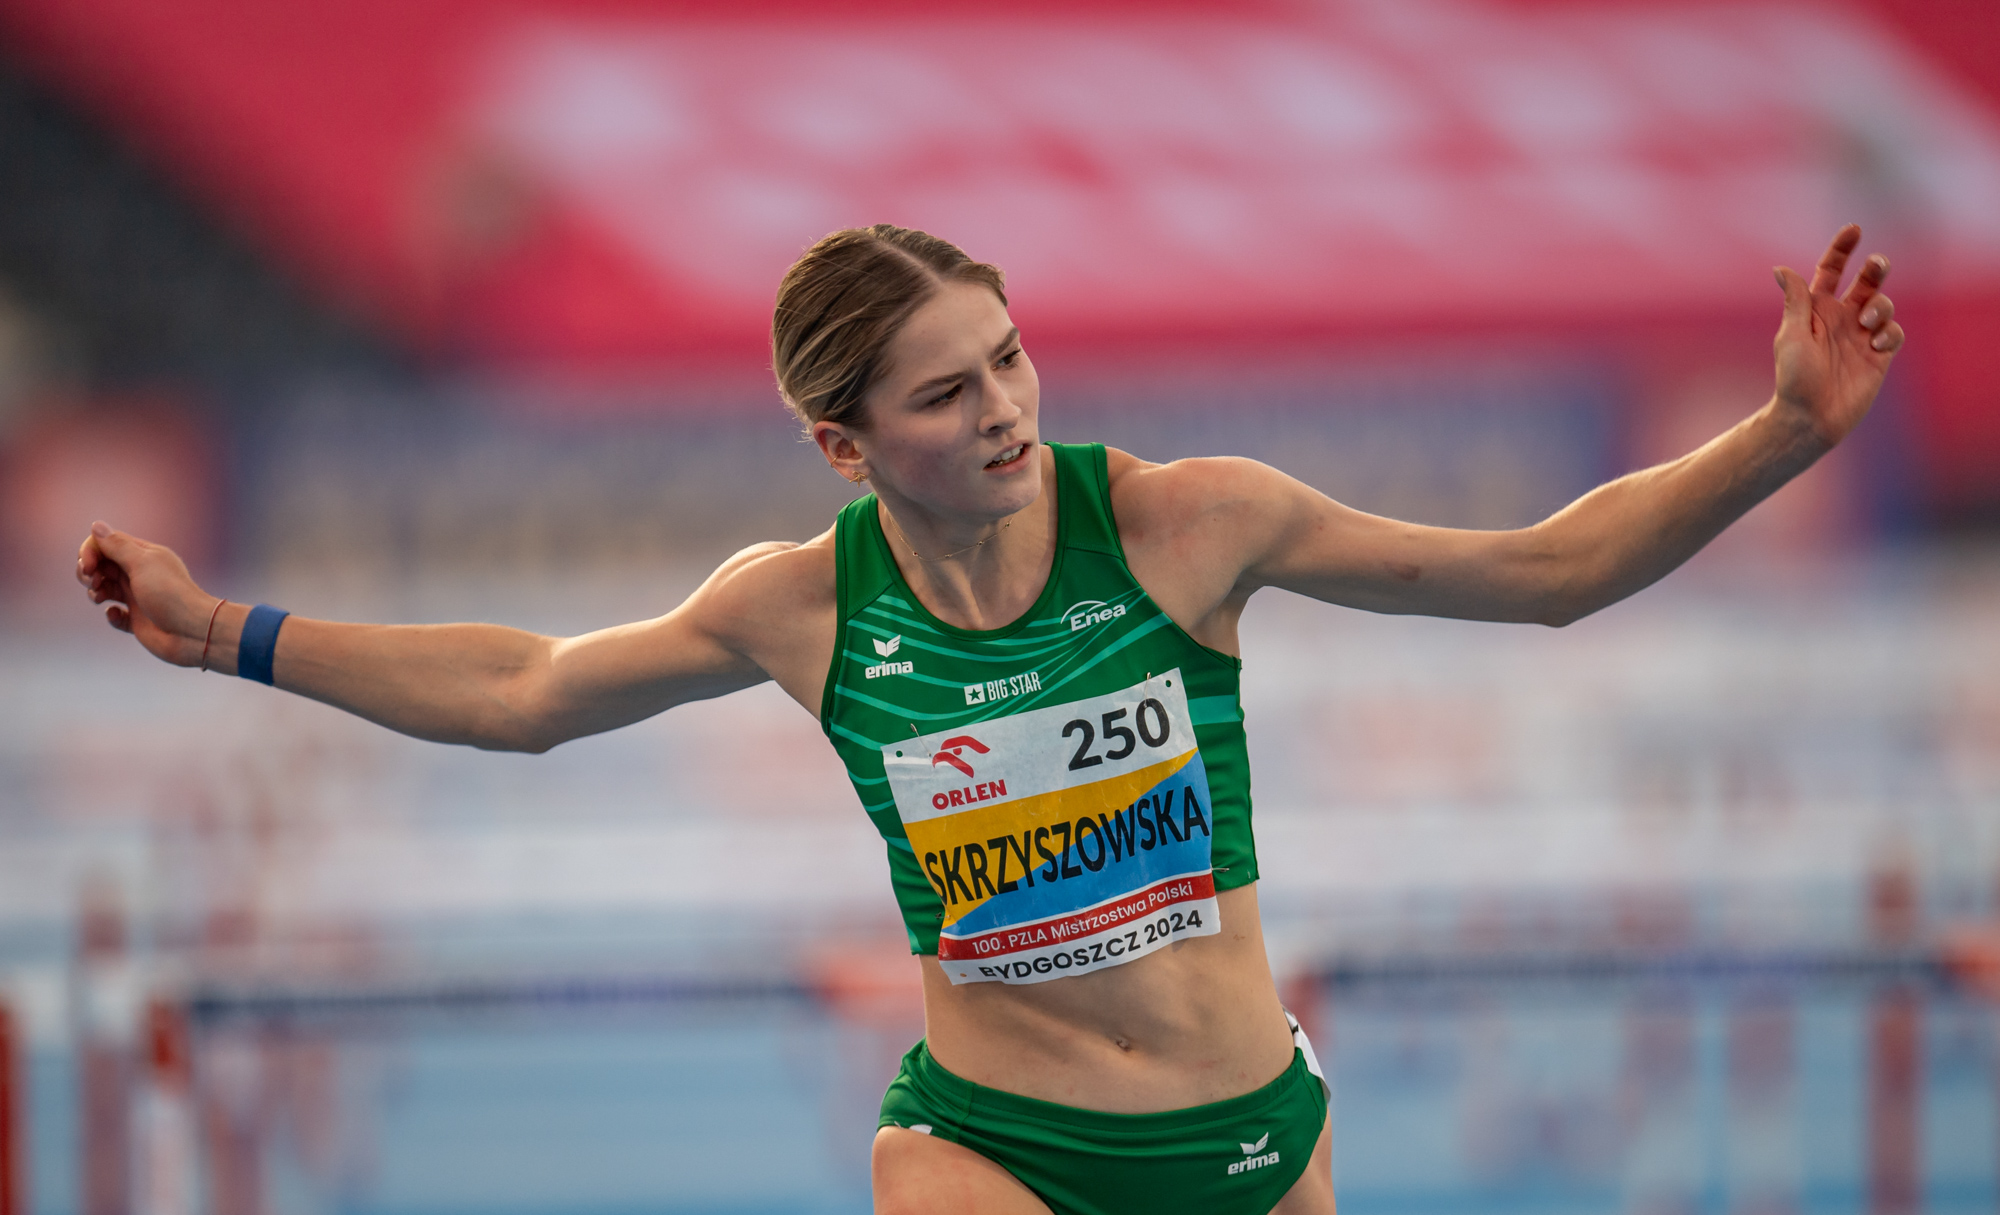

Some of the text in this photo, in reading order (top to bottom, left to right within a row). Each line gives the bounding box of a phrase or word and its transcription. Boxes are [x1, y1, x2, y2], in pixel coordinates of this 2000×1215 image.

[1070, 603, 1127, 632] Enea
[865, 661, 914, 679] erima
[988, 671, 1042, 701] BIG STAR
[1061, 698, 1171, 771] 250
[932, 779, 1008, 810] ORLEN
[924, 785, 1210, 906] SKRZYSZOWSKA
[972, 881, 1193, 955] 100. PZLA Mistrzostwa Polski
[978, 909, 1203, 979] BYDGOSZCZ 2024
[1228, 1151, 1280, 1175] erima
